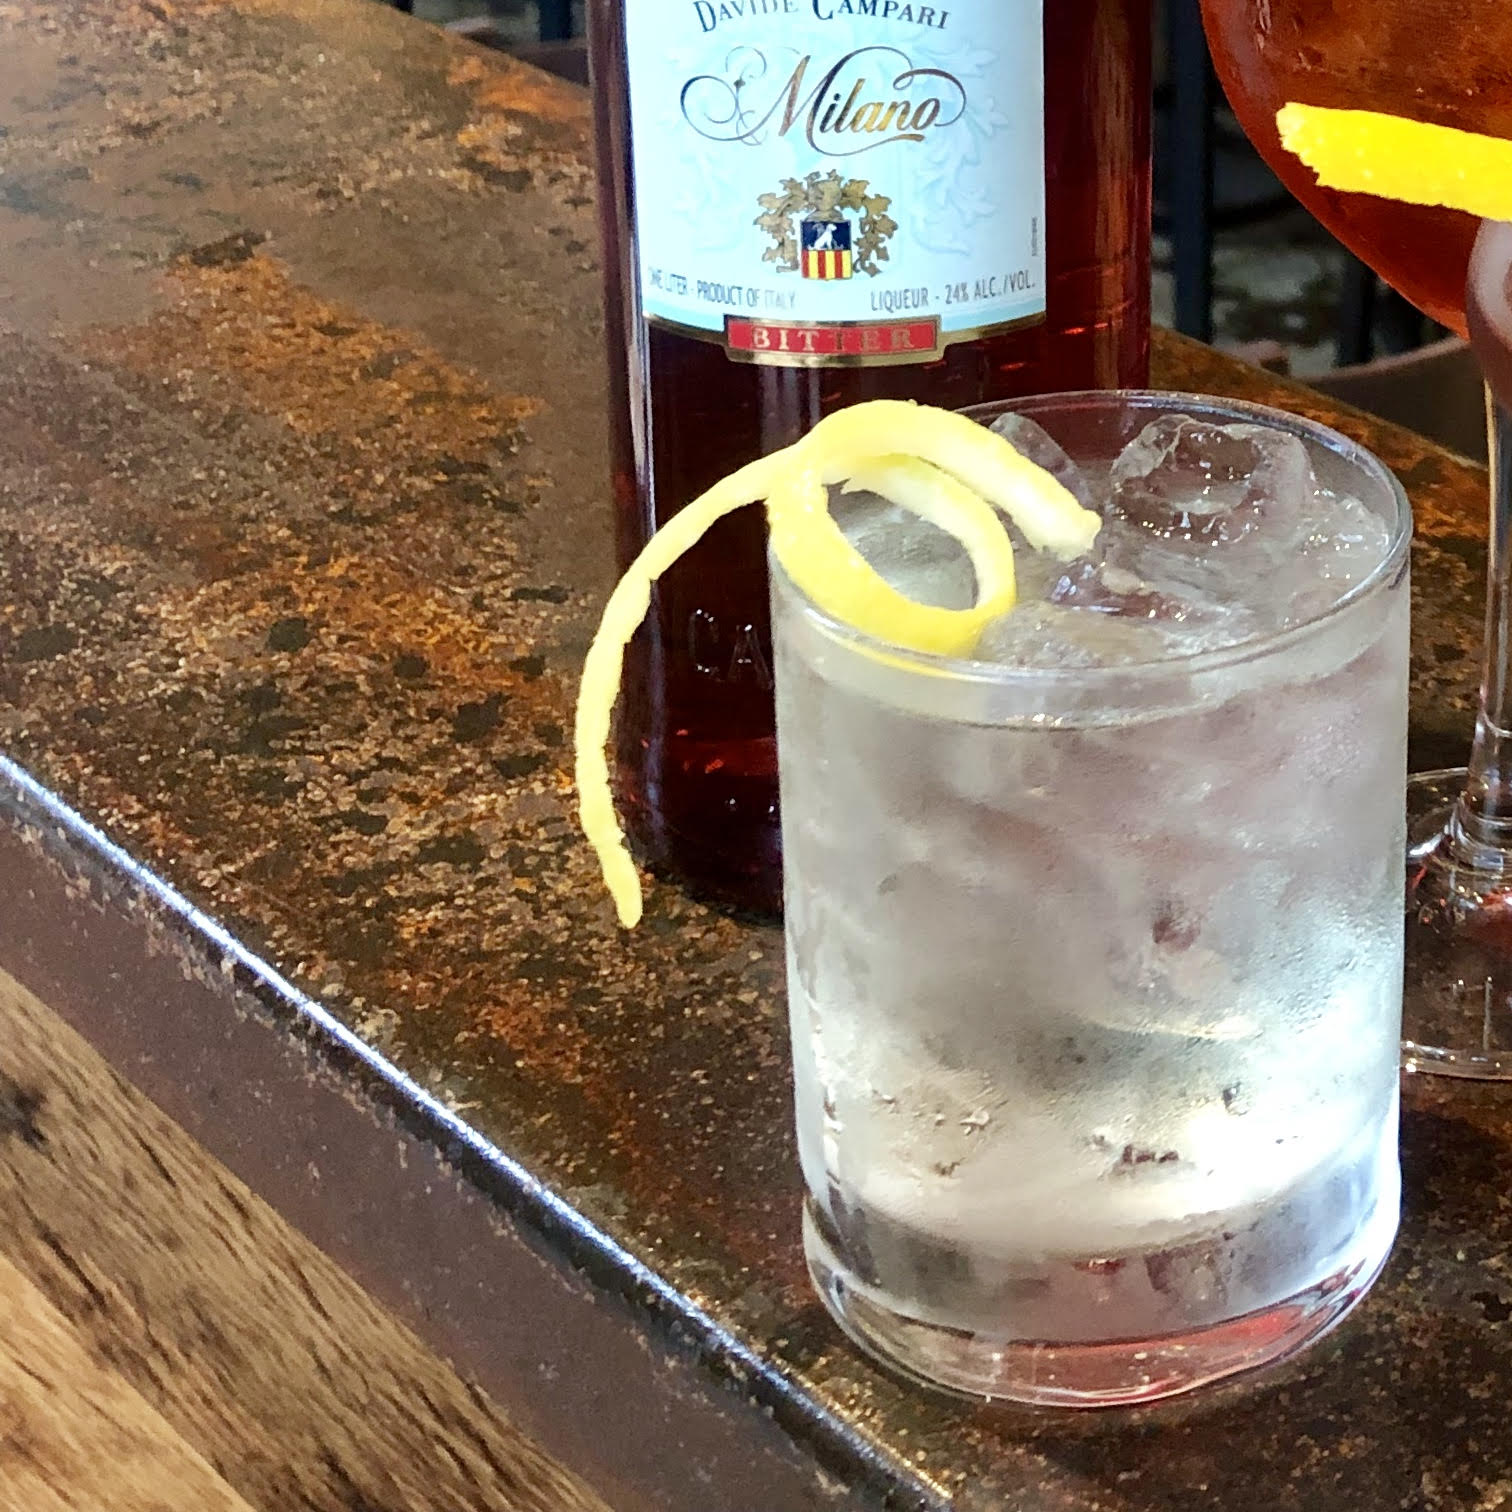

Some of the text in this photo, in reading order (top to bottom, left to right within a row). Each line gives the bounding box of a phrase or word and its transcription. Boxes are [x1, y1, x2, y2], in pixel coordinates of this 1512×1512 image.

[680, 46, 966, 156] Milano
[697, 279, 743, 305] PRODUCT
[746, 287, 760, 307] OF
[870, 287, 929, 313] LIQUEUR
[944, 283, 969, 305] 24%
[753, 327, 915, 352] BITTER
